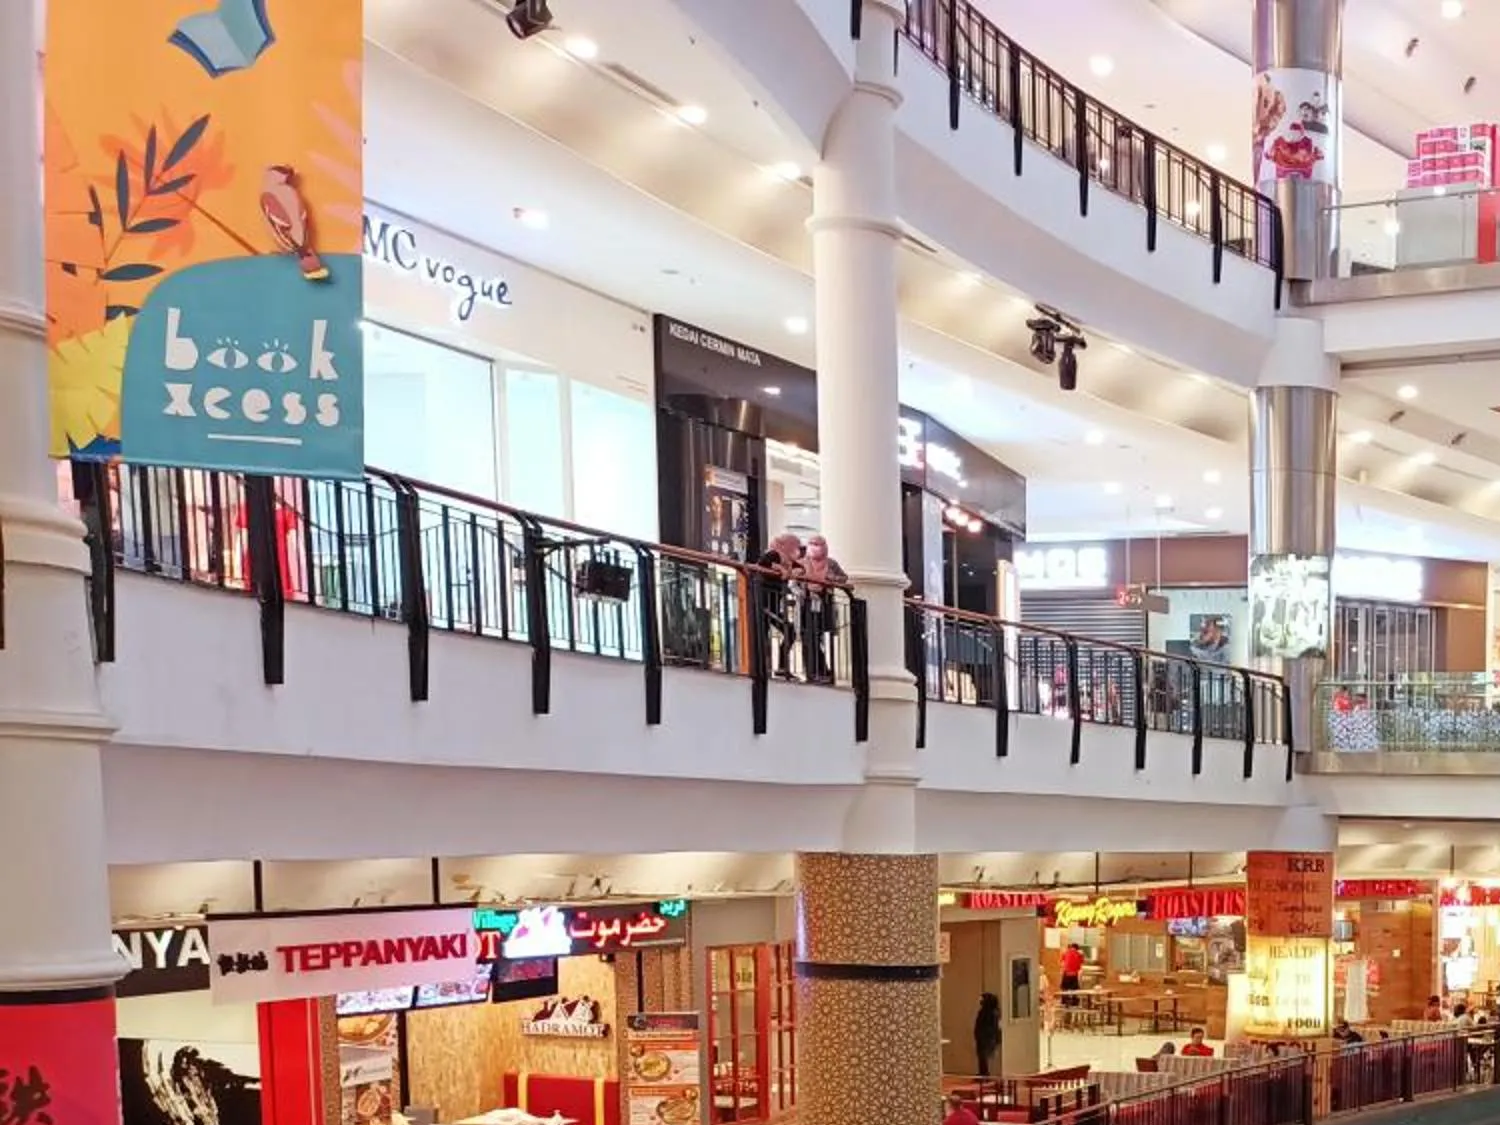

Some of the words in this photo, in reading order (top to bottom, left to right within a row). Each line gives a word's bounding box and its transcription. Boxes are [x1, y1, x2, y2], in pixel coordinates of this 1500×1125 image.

[425, 257, 513, 321] vogue
[163, 306, 340, 381] book
[737, 346, 761, 366] MATA
[163, 382, 341, 428] xcess
[276, 933, 469, 974] TEPPANYAKI
